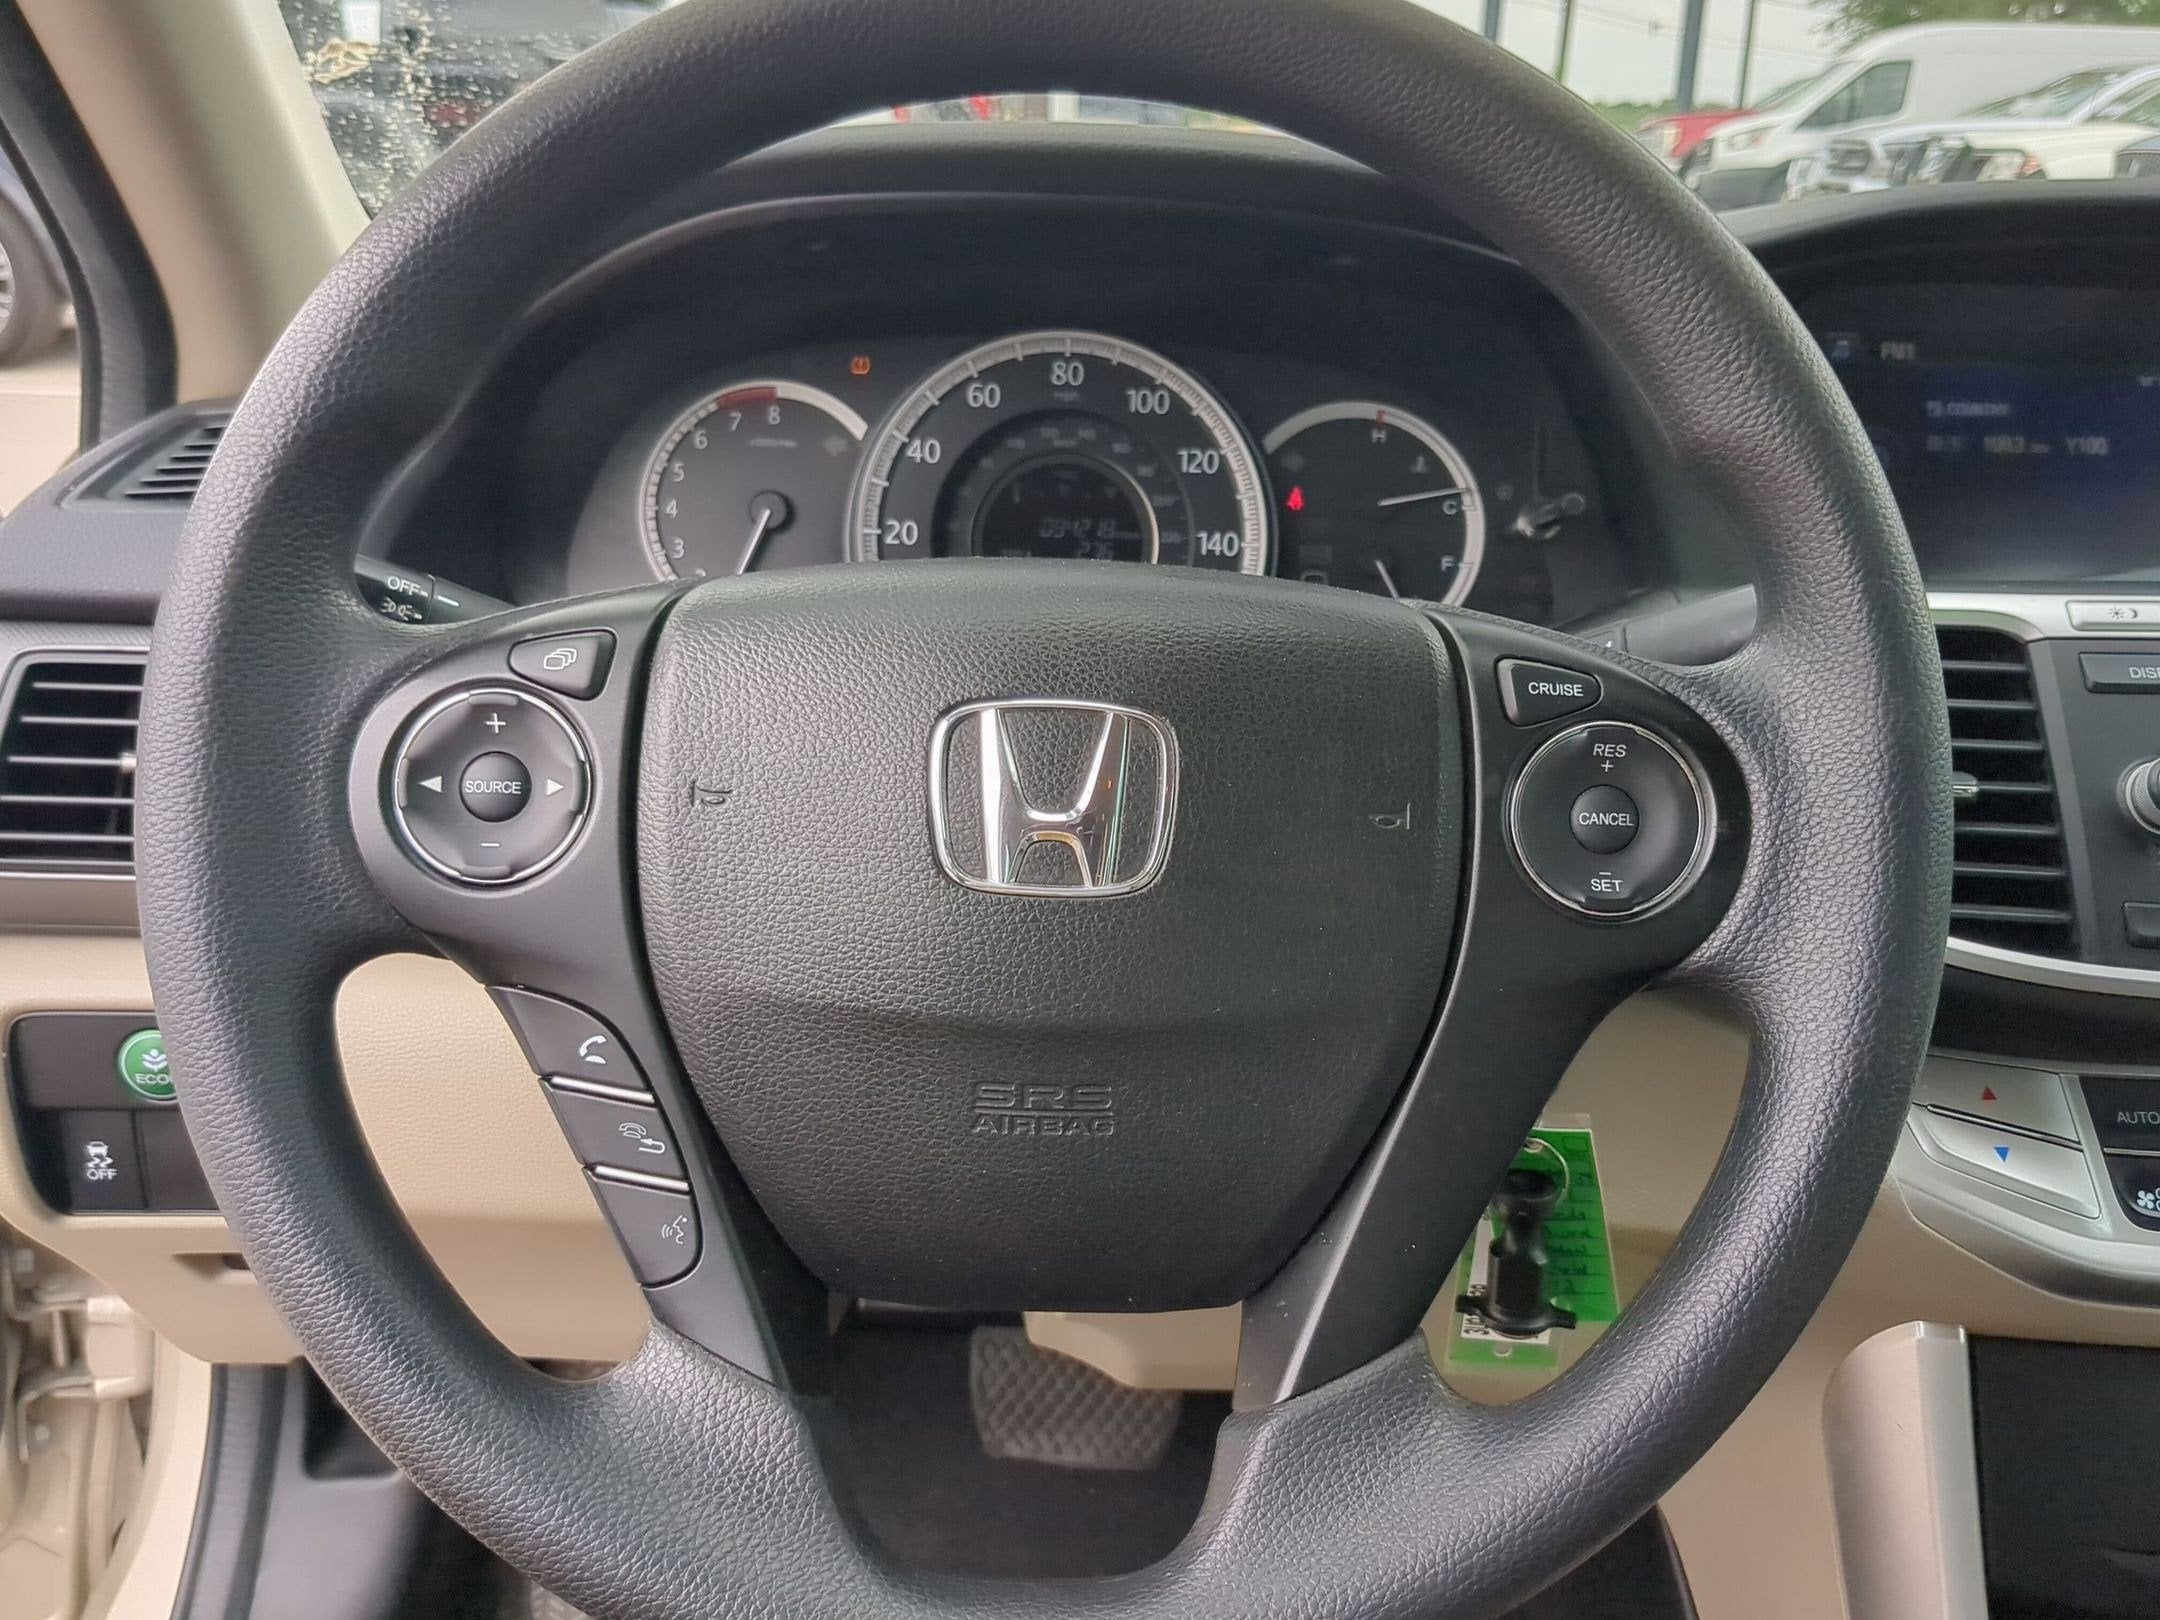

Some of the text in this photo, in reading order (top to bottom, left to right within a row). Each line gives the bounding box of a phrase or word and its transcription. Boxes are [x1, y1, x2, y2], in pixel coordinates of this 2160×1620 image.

[1050, 362, 1085, 386] 80
[967, 383, 1001, 408] 60
[1127, 389, 1170, 415] 100
[729, 412, 742, 431] 7
[768, 405, 781, 425] 8
[693, 430, 708, 450] 6
[1372, 429, 1387, 443] H
[906, 439, 941, 464] 40
[1178, 449, 1219, 475] 120
[672, 463, 685, 482] 5
[664, 499, 677, 518] 4
[1442, 501, 1457, 516] C
[885, 520, 918, 546] 20
[672, 537, 685, 558] 3
[1198, 532, 1239, 557] 140
[1440, 555, 1454, 571] F
[387, 576, 421, 596] OFF
[1528, 682, 1584, 697] CRUISE
[1592, 744, 1627, 758] RES
[464, 780, 522, 795] SOURCE
[1578, 811, 1634, 827] CANCEL
[1590, 878, 1624, 893] SET
[134, 1072, 171, 1085] ECO
[974, 1081, 1113, 1111] SRS
[971, 1114, 1115, 1137] AIRBAG
[2117, 1111, 2160, 1125] AUTO
[86, 1168, 119, 1181] OFF
